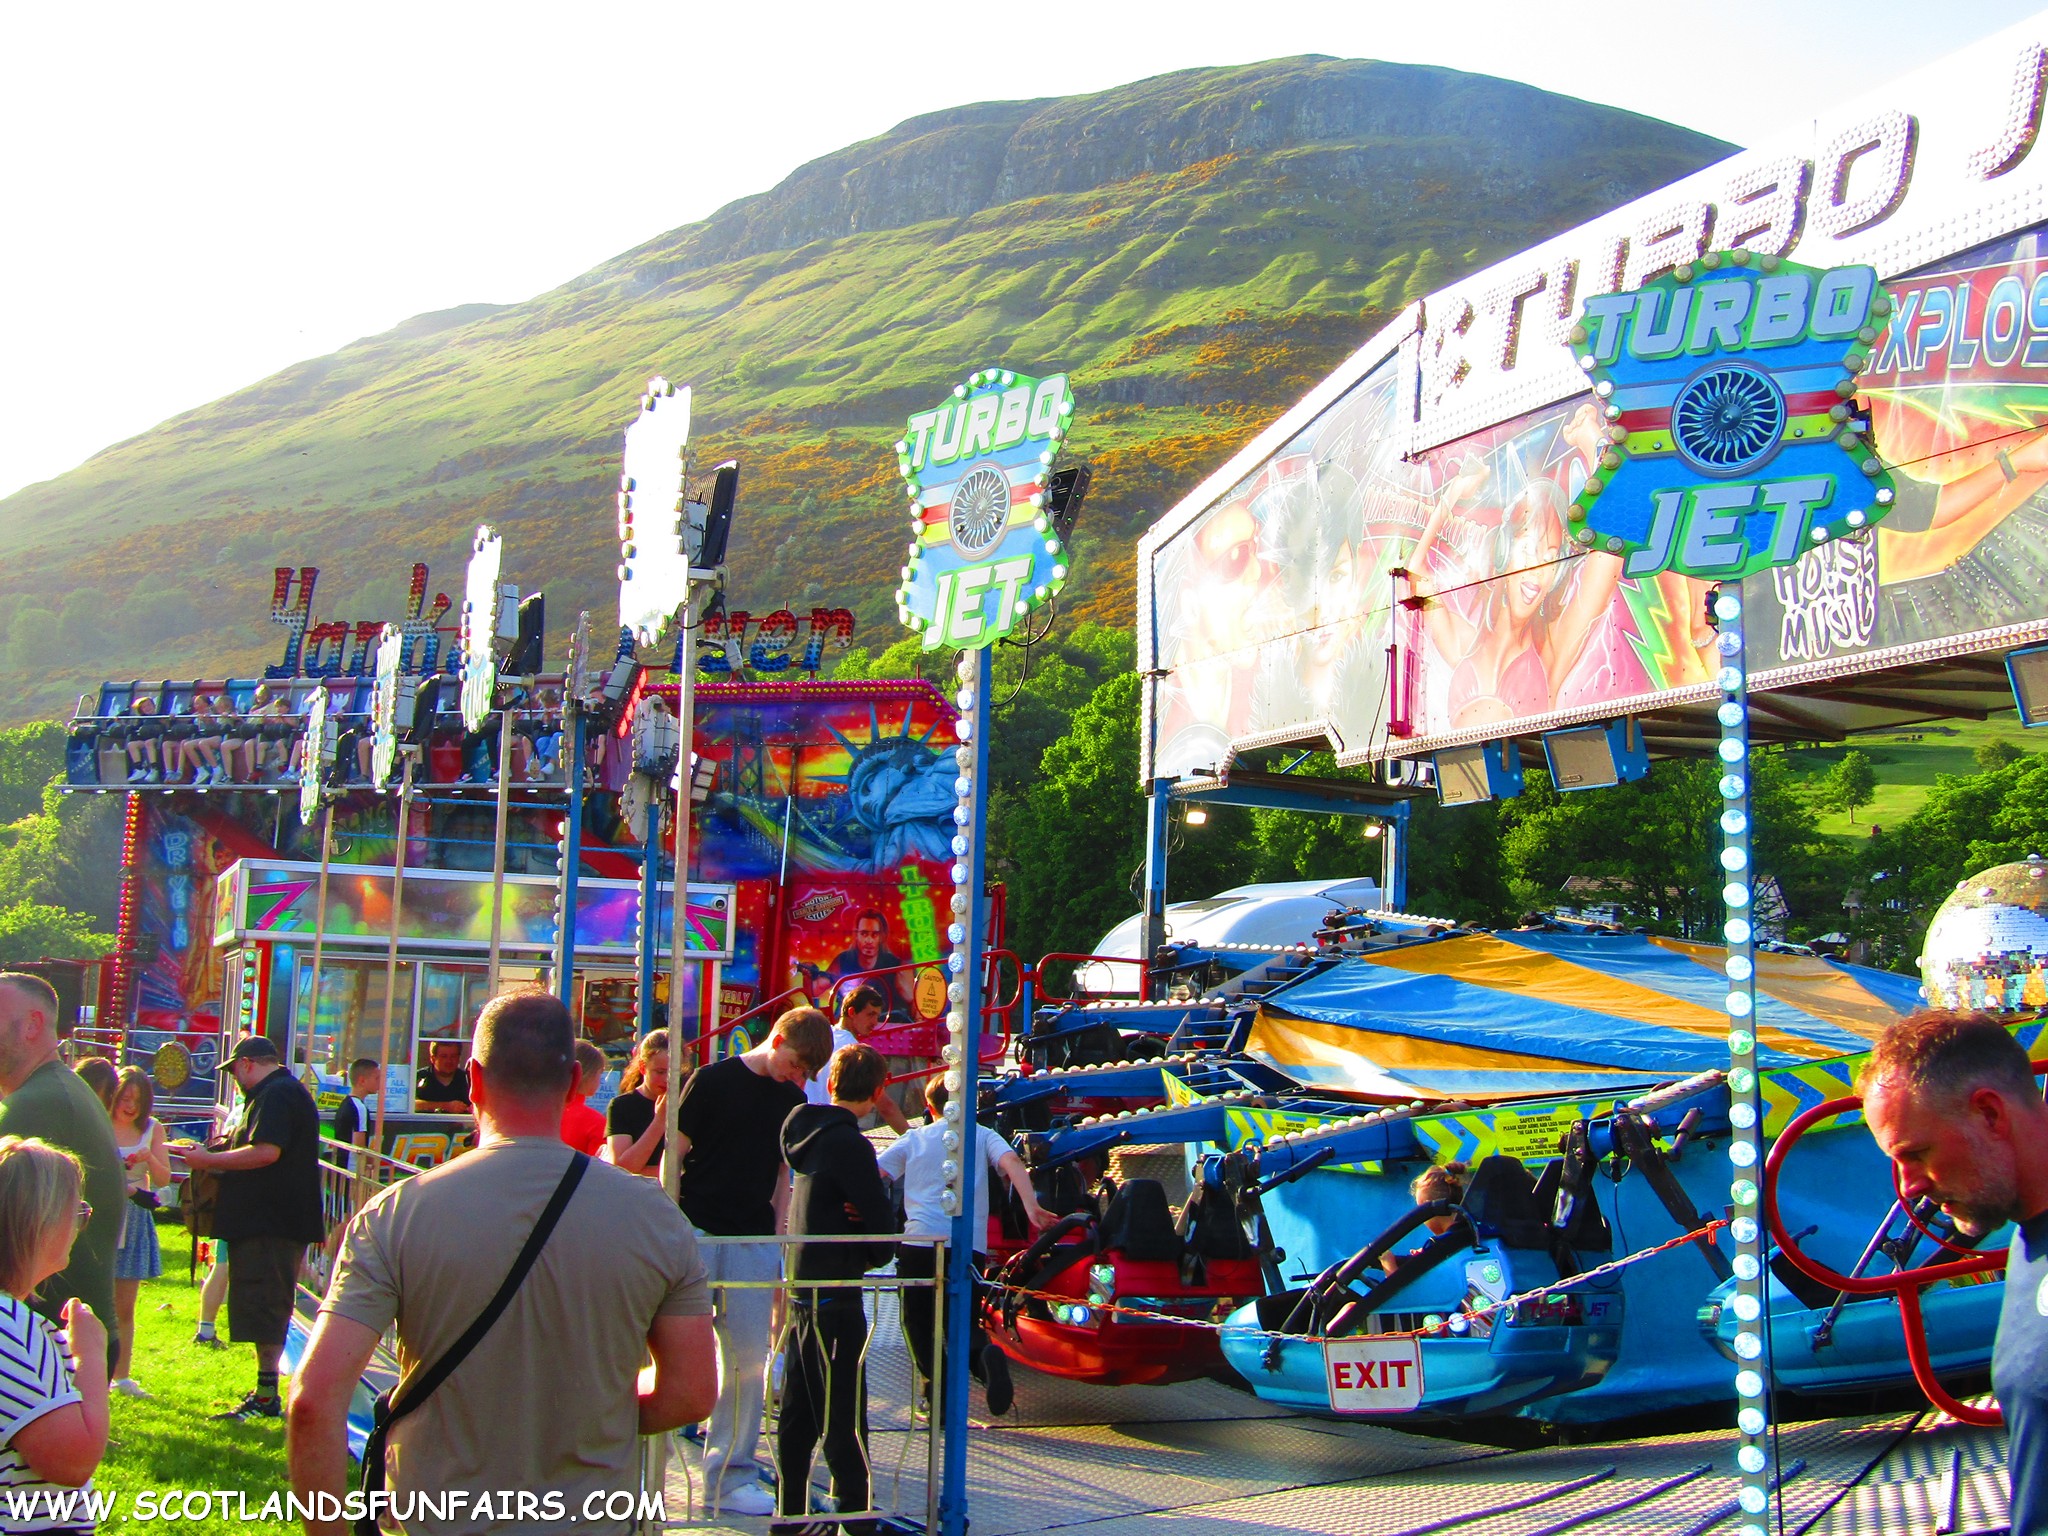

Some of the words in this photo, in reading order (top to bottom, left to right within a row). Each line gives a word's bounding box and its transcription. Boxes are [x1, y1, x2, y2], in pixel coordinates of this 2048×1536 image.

[1585, 267, 1875, 361] TURBO
[910, 375, 1068, 467] TURBO
[1626, 479, 1832, 574] JET
[924, 557, 1032, 647] JET
[1333, 1360, 1413, 1389] EXIT
